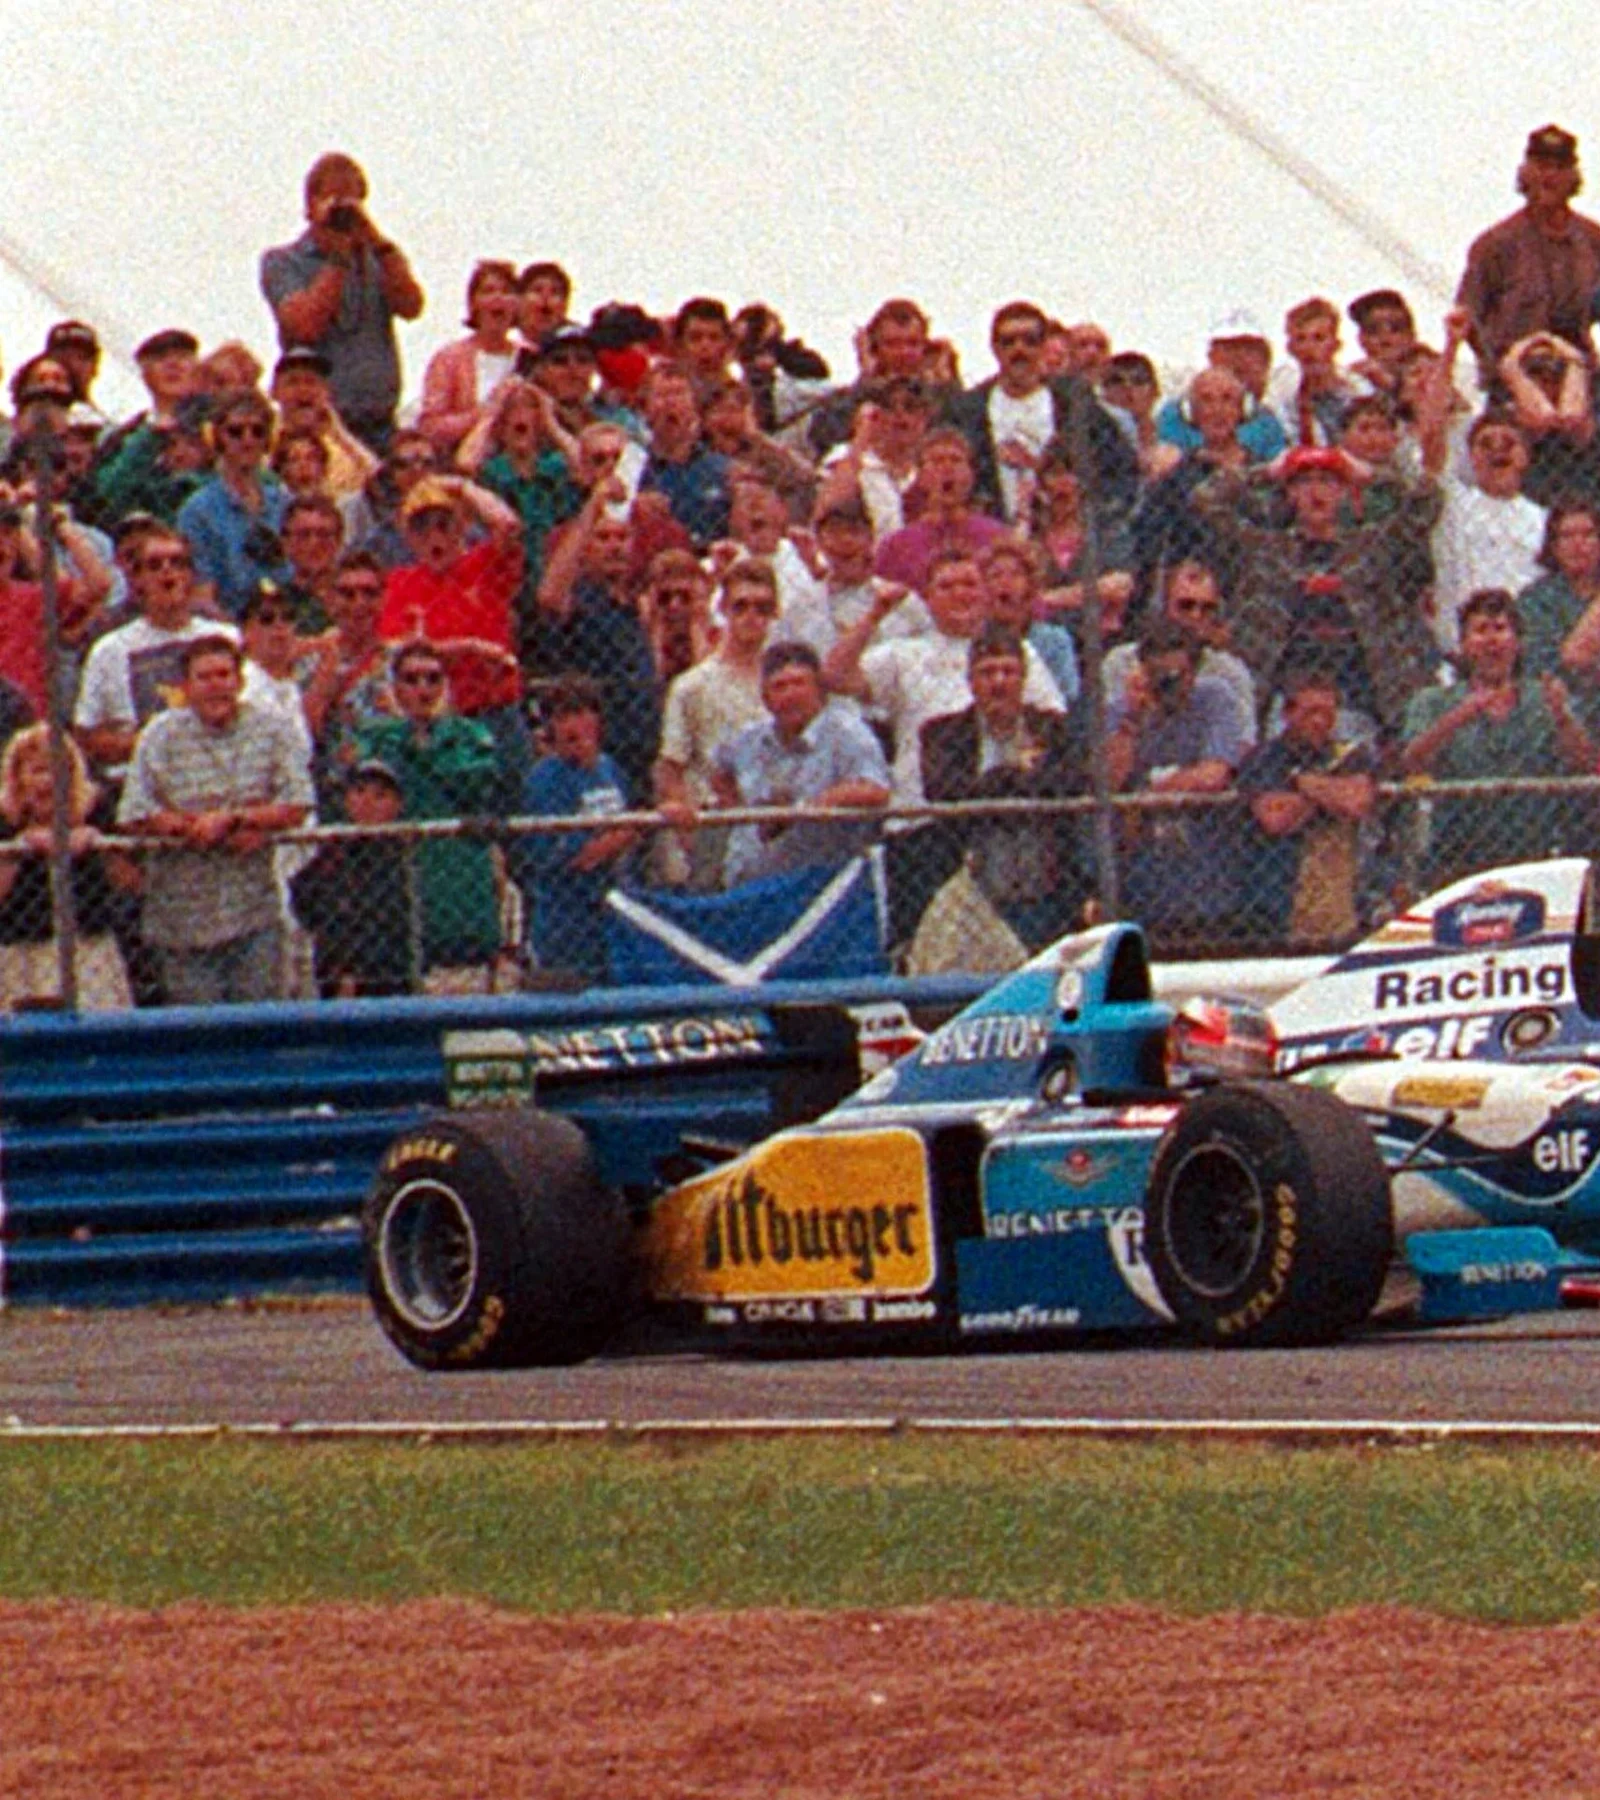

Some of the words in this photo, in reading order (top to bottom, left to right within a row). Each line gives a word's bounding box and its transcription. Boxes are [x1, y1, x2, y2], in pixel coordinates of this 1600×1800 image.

[1375, 956, 1566, 1010] Racing
[920, 1016, 1048, 1067] BENETTON
[1394, 1016, 1494, 1061] elf
[1533, 1128, 1588, 1173] elf
